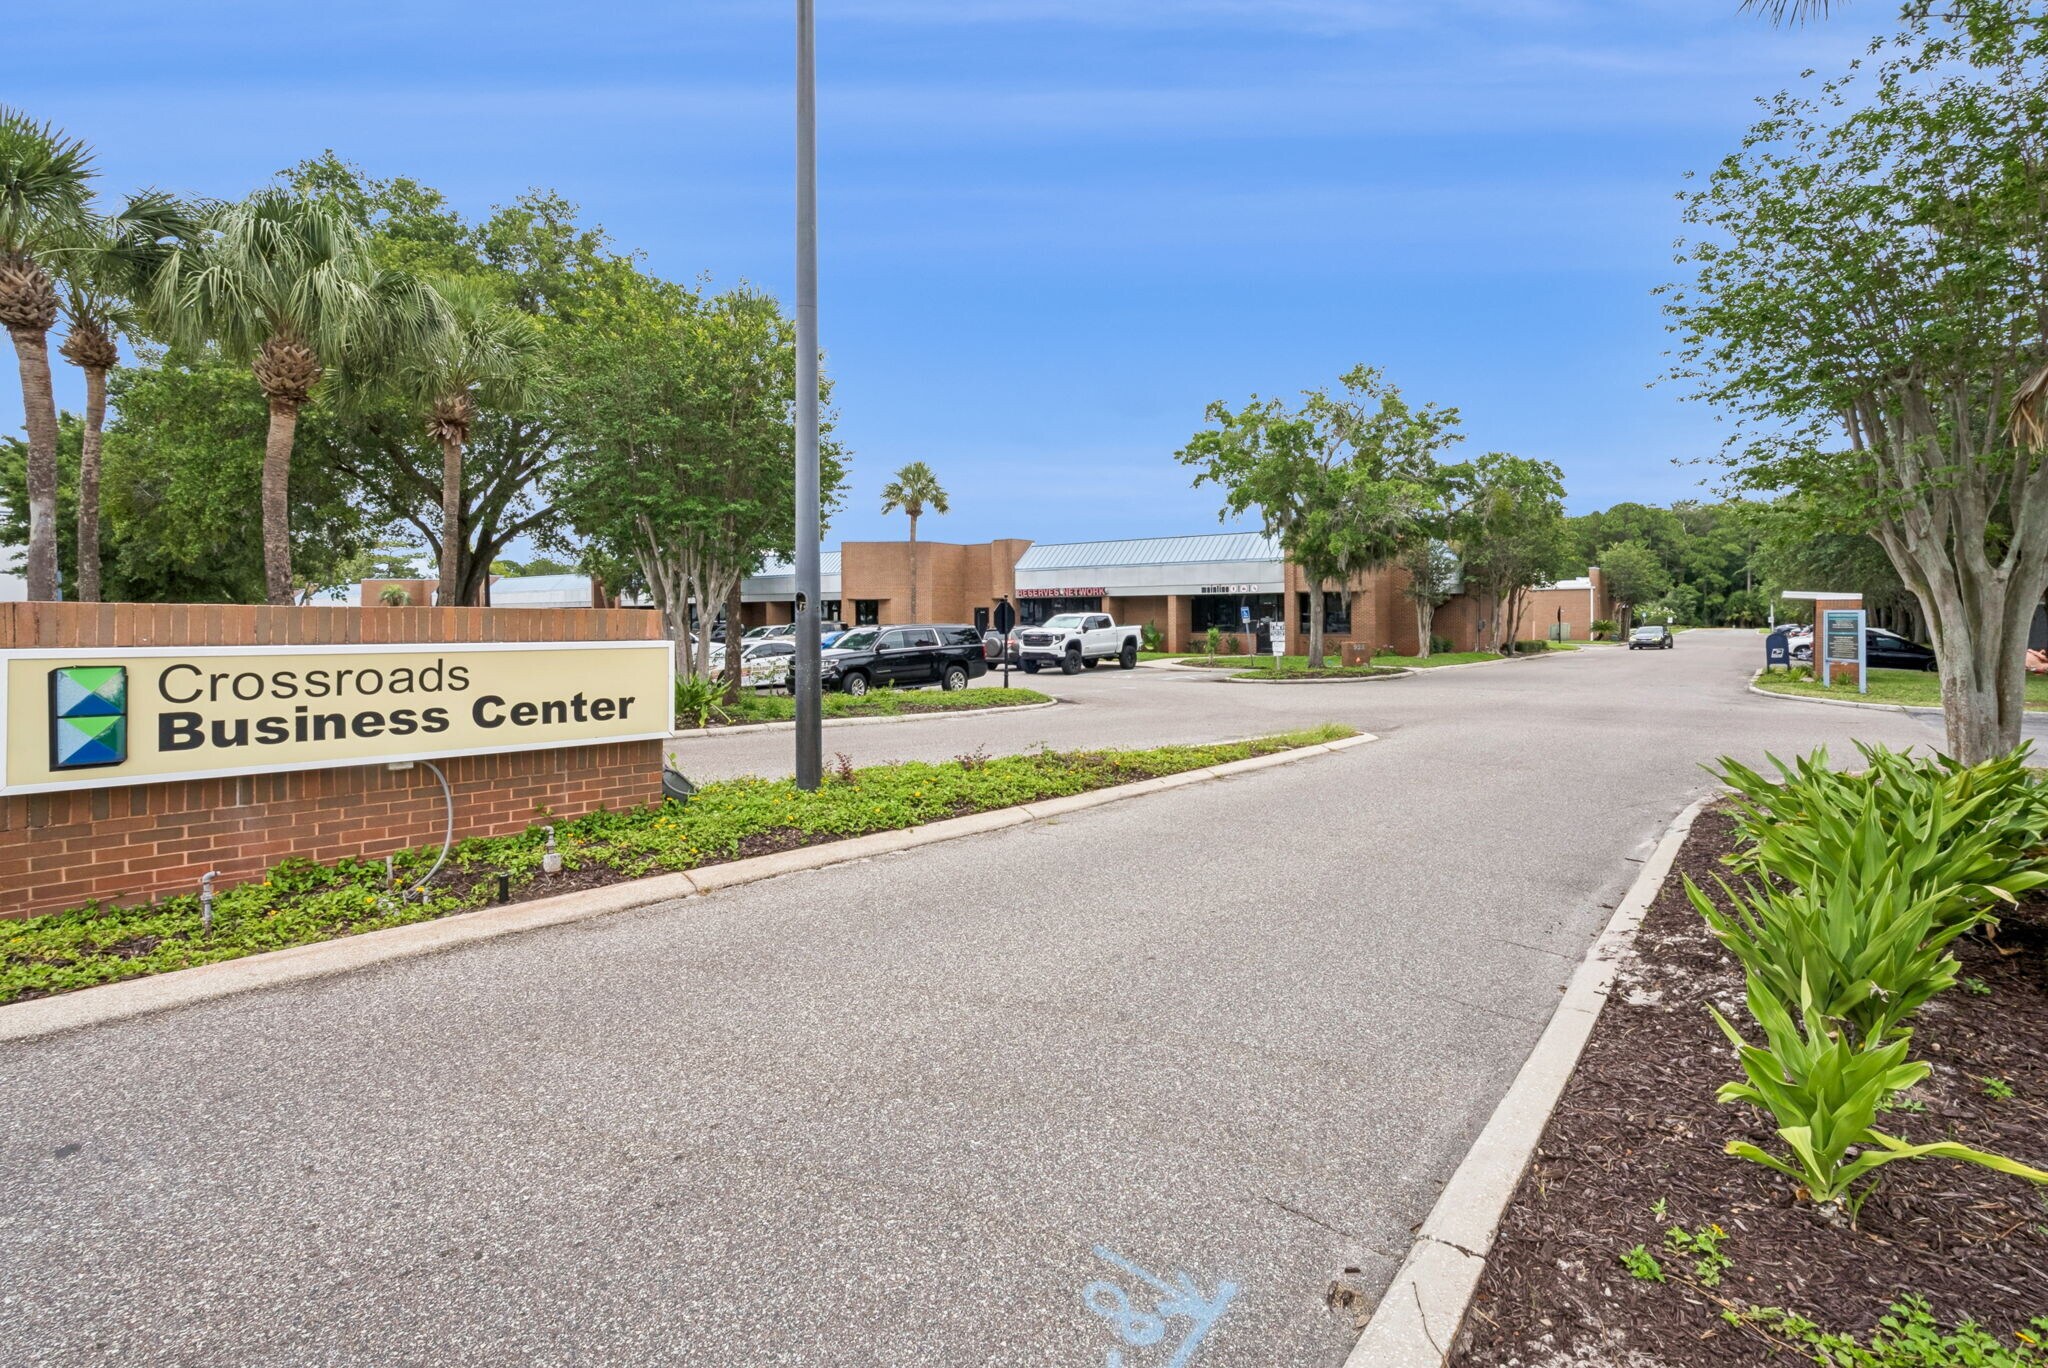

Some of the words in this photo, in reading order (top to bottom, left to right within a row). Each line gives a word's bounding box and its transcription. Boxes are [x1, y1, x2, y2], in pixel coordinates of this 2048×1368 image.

[1062, 586, 1106, 597] NETWORK
[158, 658, 470, 704] Crossroads
[158, 705, 450, 752] Business
[472, 692, 636, 729] Center
